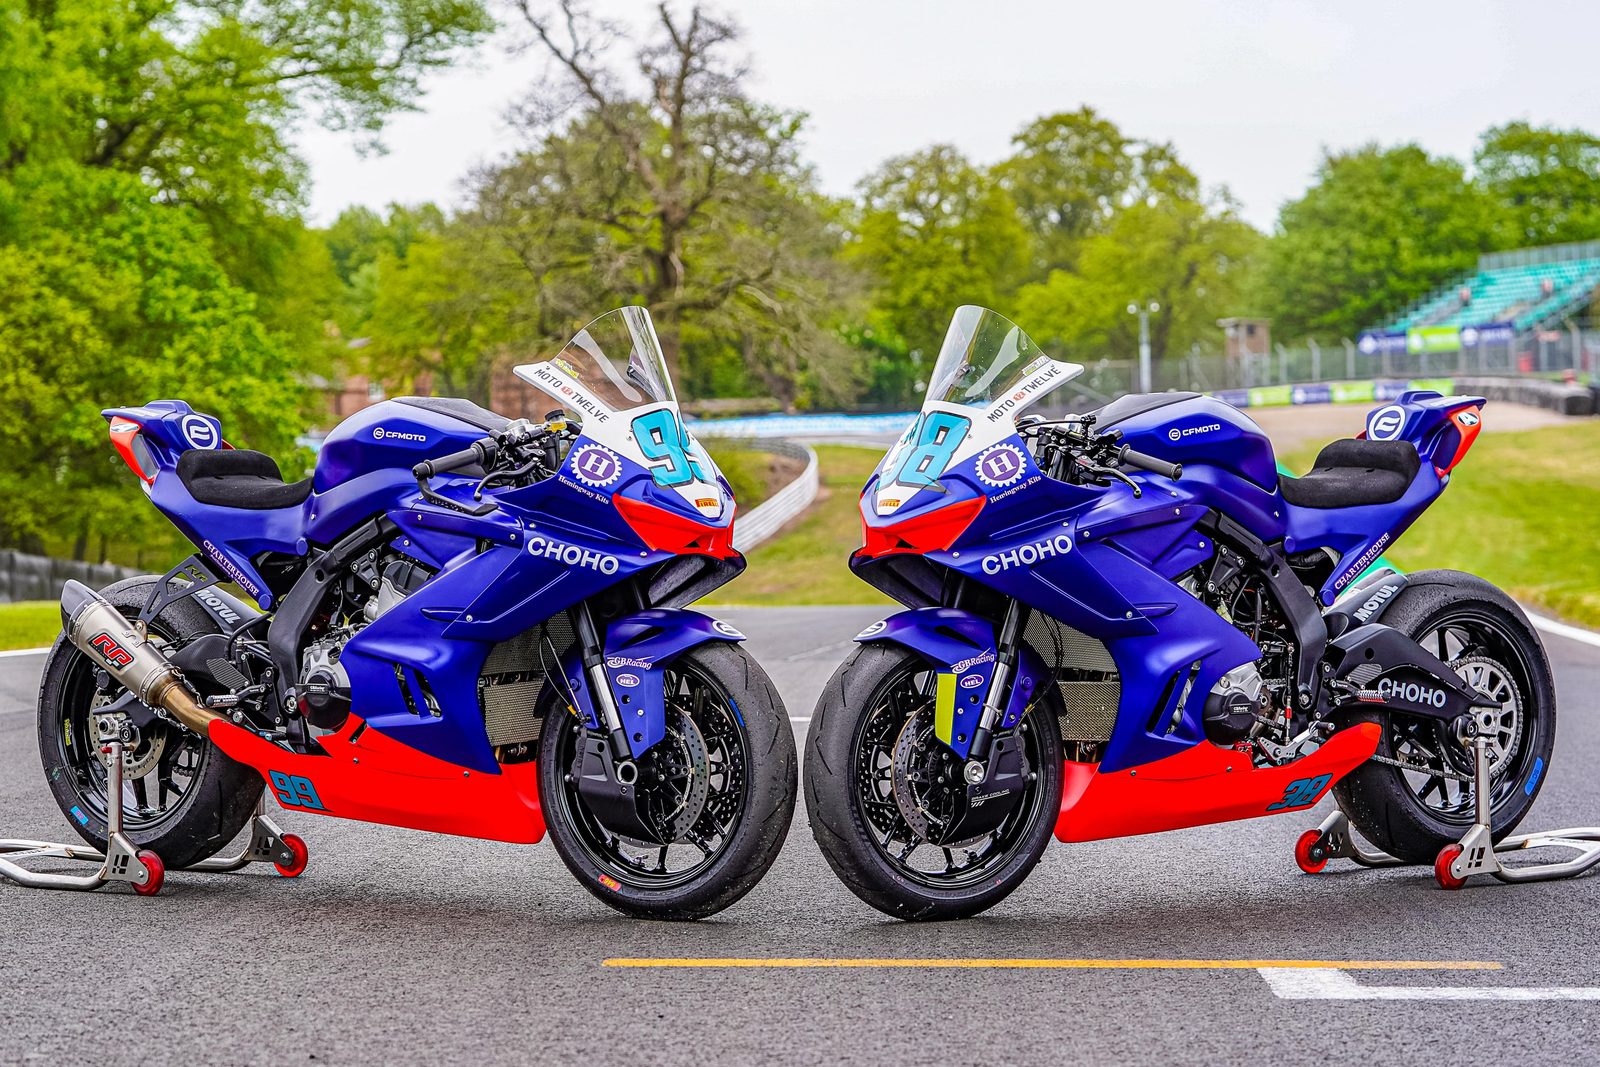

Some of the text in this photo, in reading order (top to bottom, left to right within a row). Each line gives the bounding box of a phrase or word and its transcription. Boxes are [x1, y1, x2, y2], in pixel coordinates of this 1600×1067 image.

[534, 368, 563, 388] MOTO
[571, 391, 610, 423] TWELVE
[987, 399, 1015, 423] MOTO
[1021, 367, 1061, 394] TWELVE
[385, 430, 426, 442] CFMOTO
[1182, 423, 1221, 437] CFMOTO
[581, 451, 612, 478] H
[985, 451, 1017, 478] H
[558, 474, 609, 505] Hemingway Kits
[990, 475, 1042, 504] Hemingway Kits
[203, 539, 260, 597] CHARTERHOUSE
[527, 536, 619, 575] CHOHO
[982, 534, 1072, 575] CHOHO
[1334, 532, 1390, 590] CHARTERHOUSE
[195, 589, 241, 625] MOTUL
[1353, 584, 1399, 622] MOTUL
[608, 656, 652, 671] GBRacing
[953, 654, 994, 673] GBRacing
[1377, 678, 1447, 708] CHOHO
[268, 769, 329, 811] 99
[1266, 773, 1334, 811] 38
